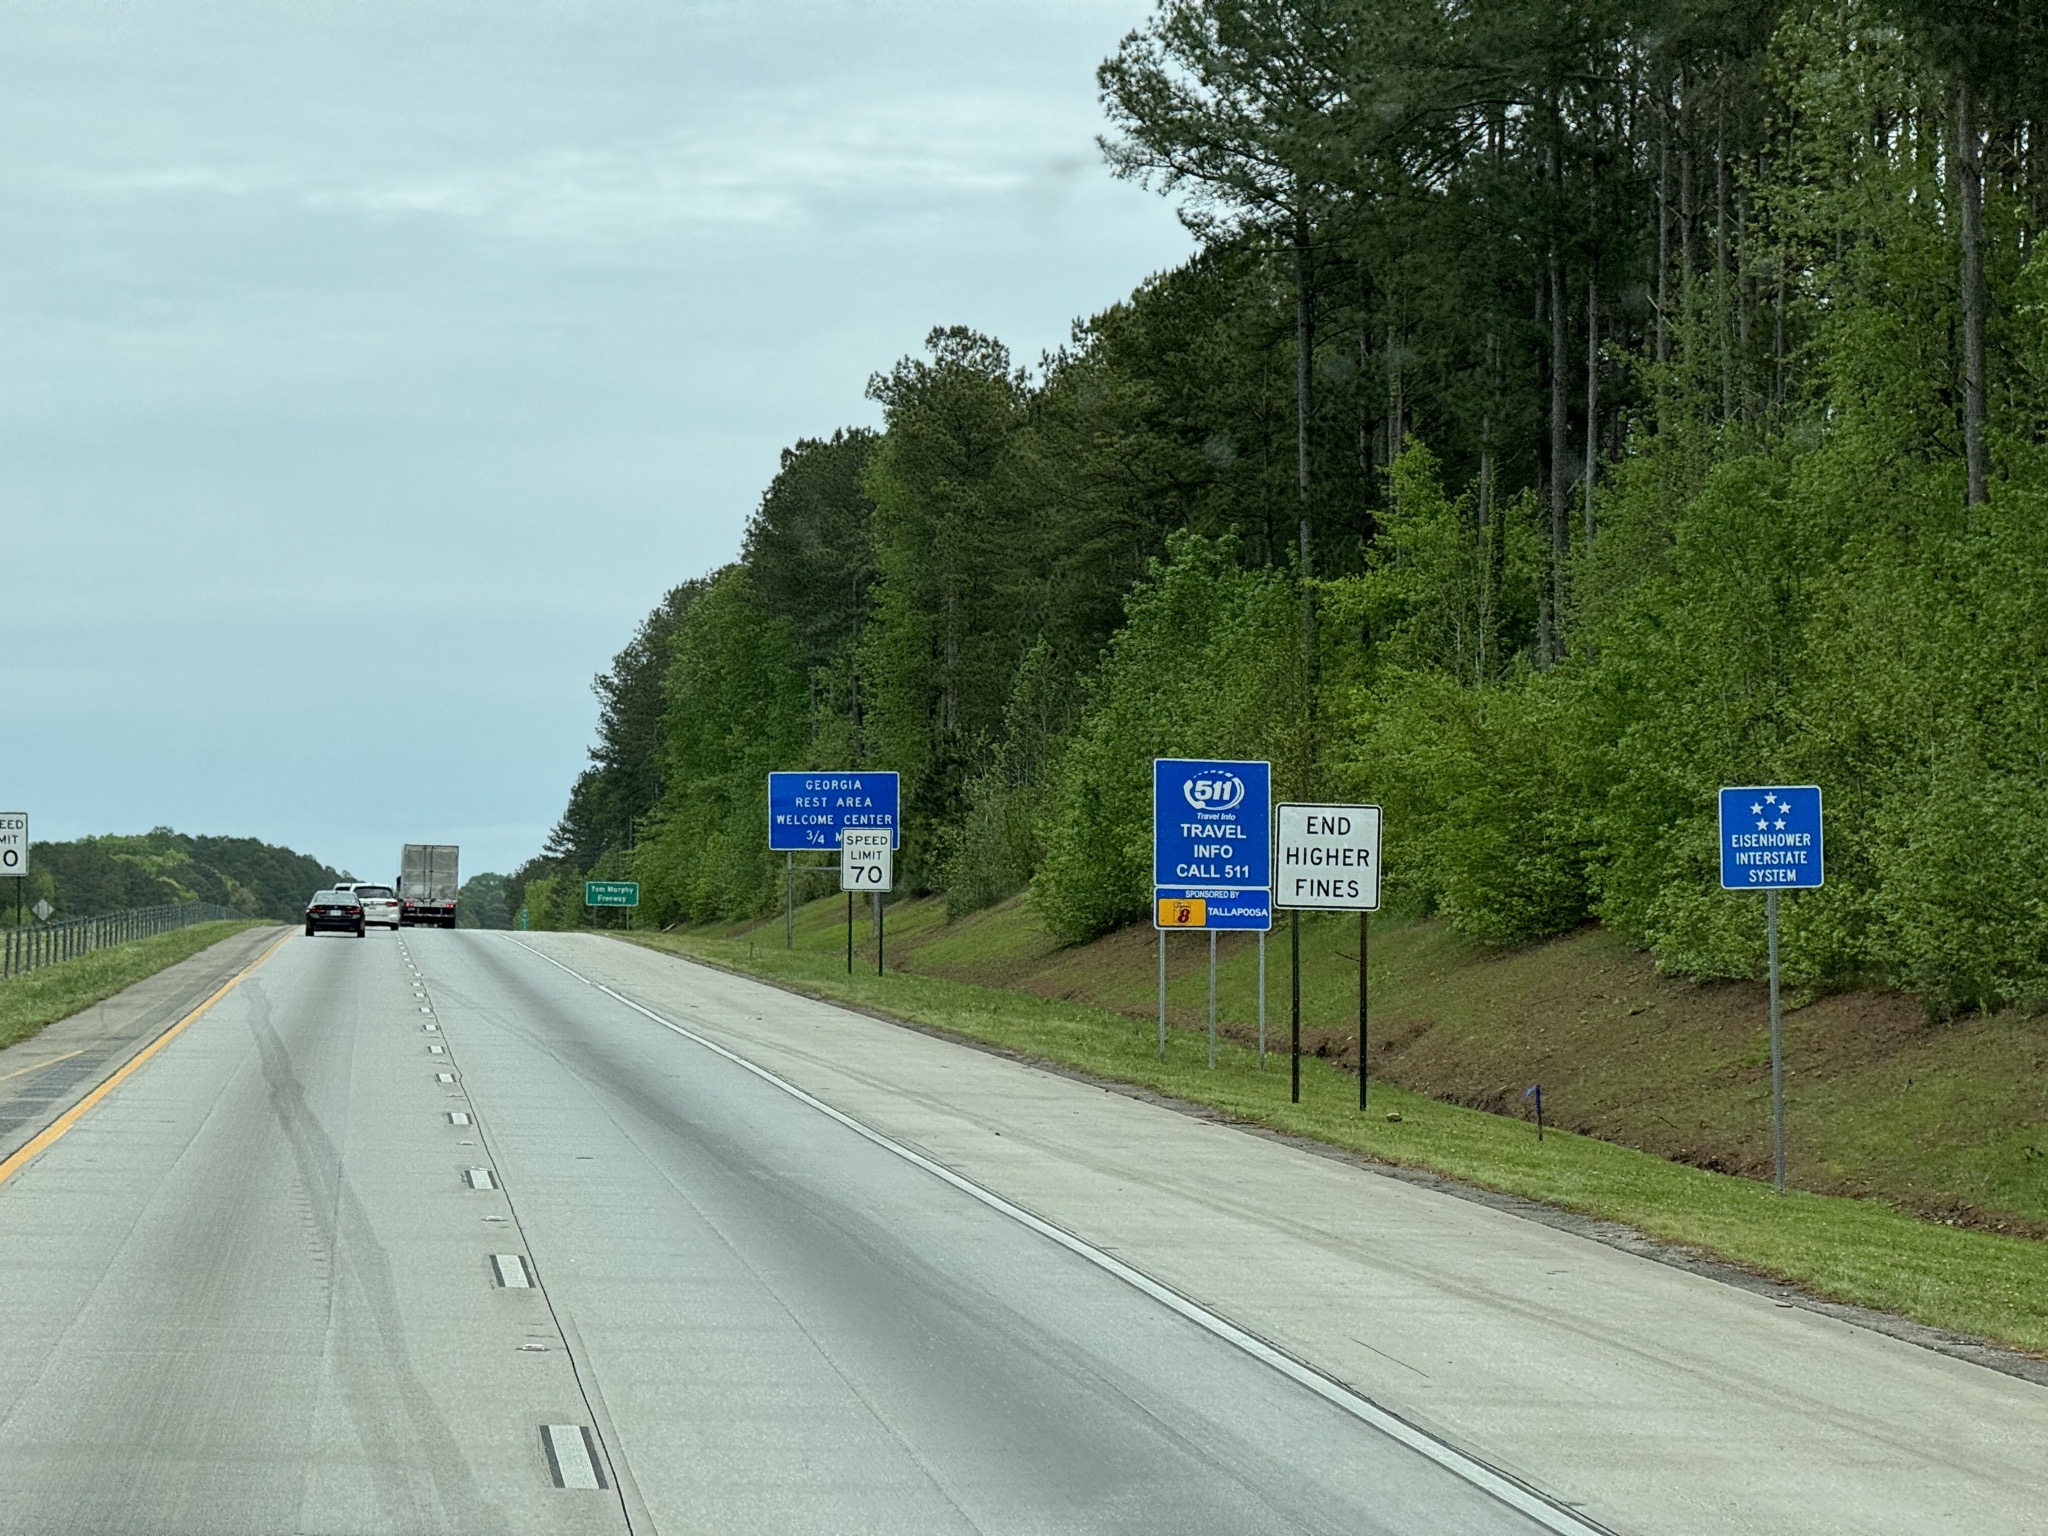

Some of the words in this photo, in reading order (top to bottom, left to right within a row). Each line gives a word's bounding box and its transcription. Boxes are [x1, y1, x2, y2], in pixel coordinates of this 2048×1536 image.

[805, 780, 862, 790] GEORGIA
[1194, 780, 1232, 801] 511
[795, 797, 828, 808] REST
[836, 797, 872, 807] AREA
[776, 815, 834, 825] WELCOME
[844, 815, 892, 825] CENTER
[1196, 812, 1219, 820] Travel
[1220, 812, 1236, 821] Info
[0, 820, 24, 829] EED
[1181, 823, 1247, 839] TRAVEL
[1307, 816, 1351, 835] END
[0, 835, 18, 844] MIT
[806, 830, 824, 844] 3/4
[846, 835, 888, 845] SPEED
[1731, 833, 1811, 848] EISENHOWER
[3, 849, 18, 867] 0
[850, 850, 883, 860] LIMIT
[1193, 845, 1233, 859] INFO
[1286, 847, 1370, 867] HIGHER
[1735, 851, 1808, 865] INTERSTATE
[850, 866, 883, 883] 70
[1176, 864, 1220, 878] CALL
[1224, 865, 1249, 879] 511
[1748, 869, 1797, 883] SYSTEM
[607, 886, 633, 894] Murphy
[1185, 890, 1228, 899] SPONSORED
[1230, 891, 1240, 899] BY
[1295, 878, 1359, 898] FINES
[597, 895, 627, 903] Freeway
[1177, 908, 1191, 923] 8
[1208, 907, 1268, 917] TALLAPOOSA
